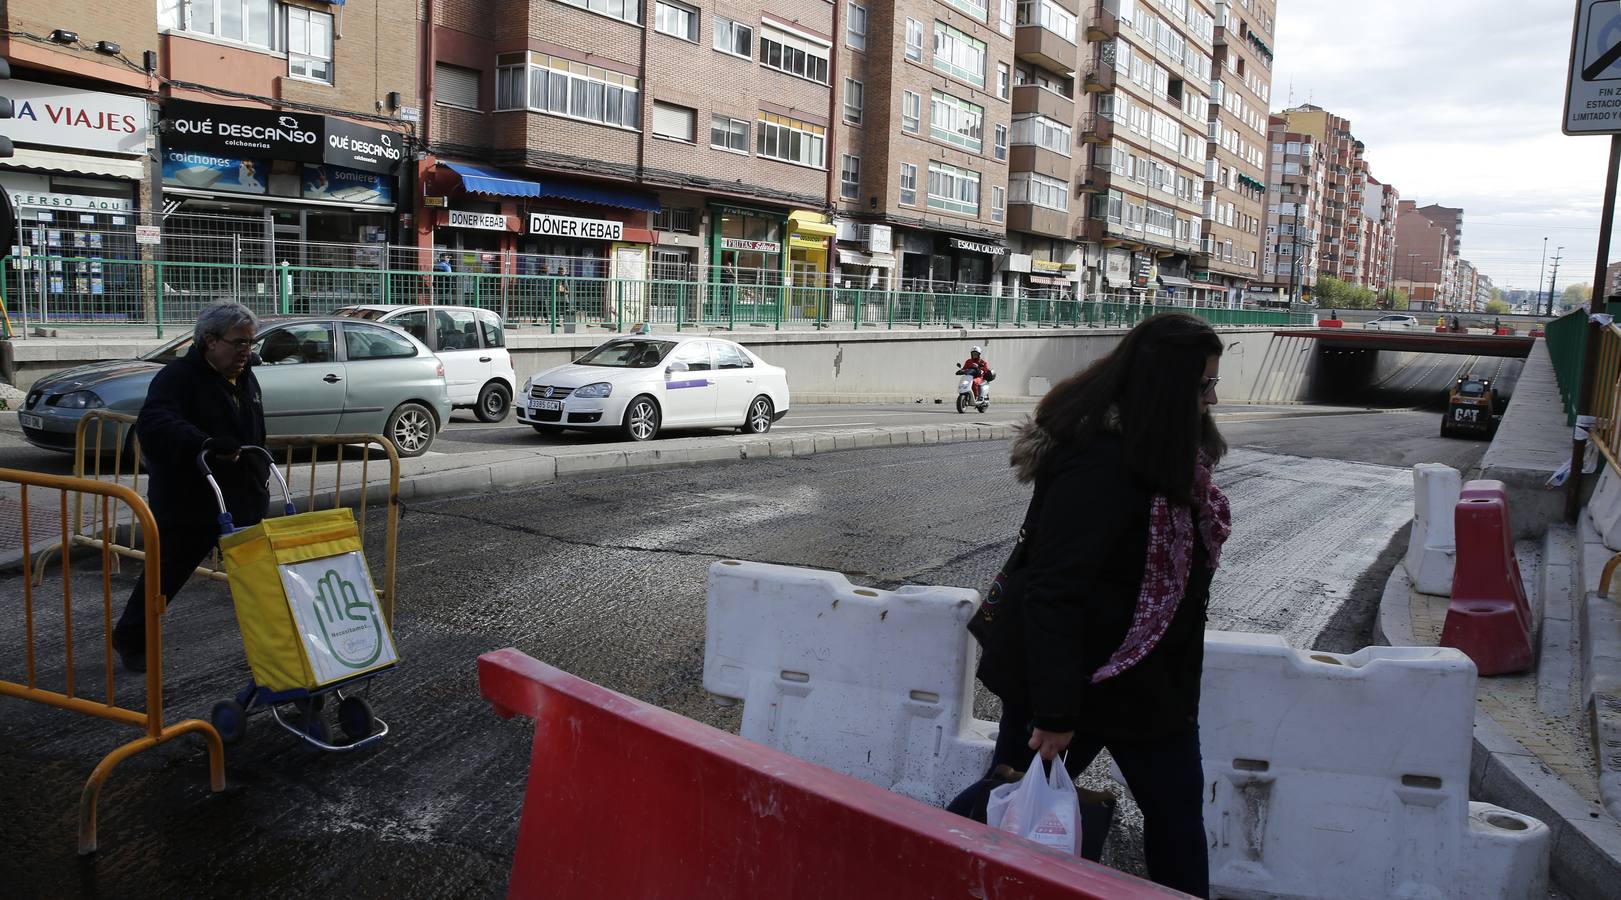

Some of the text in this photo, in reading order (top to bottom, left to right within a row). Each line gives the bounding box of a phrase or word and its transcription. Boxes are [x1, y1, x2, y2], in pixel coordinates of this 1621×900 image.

[1599, 88, 1613, 96] FIN
[45, 104, 136, 134] VIAJES
[1572, 112, 1610, 121] LIMITADO
[175, 118, 317, 144] QUÉ DESCANSO
[329, 135, 400, 160] QUÉ DESCANSO
[169, 152, 230, 168] colchones
[335, 170, 378, 184] somieres
[480, 216, 504, 228] KEBAB
[533, 215, 620, 239] DÖNER KEBAB
[957, 240, 1005, 255] ESKALA CALZADOS
[1455, 408, 1479, 422] CAT
